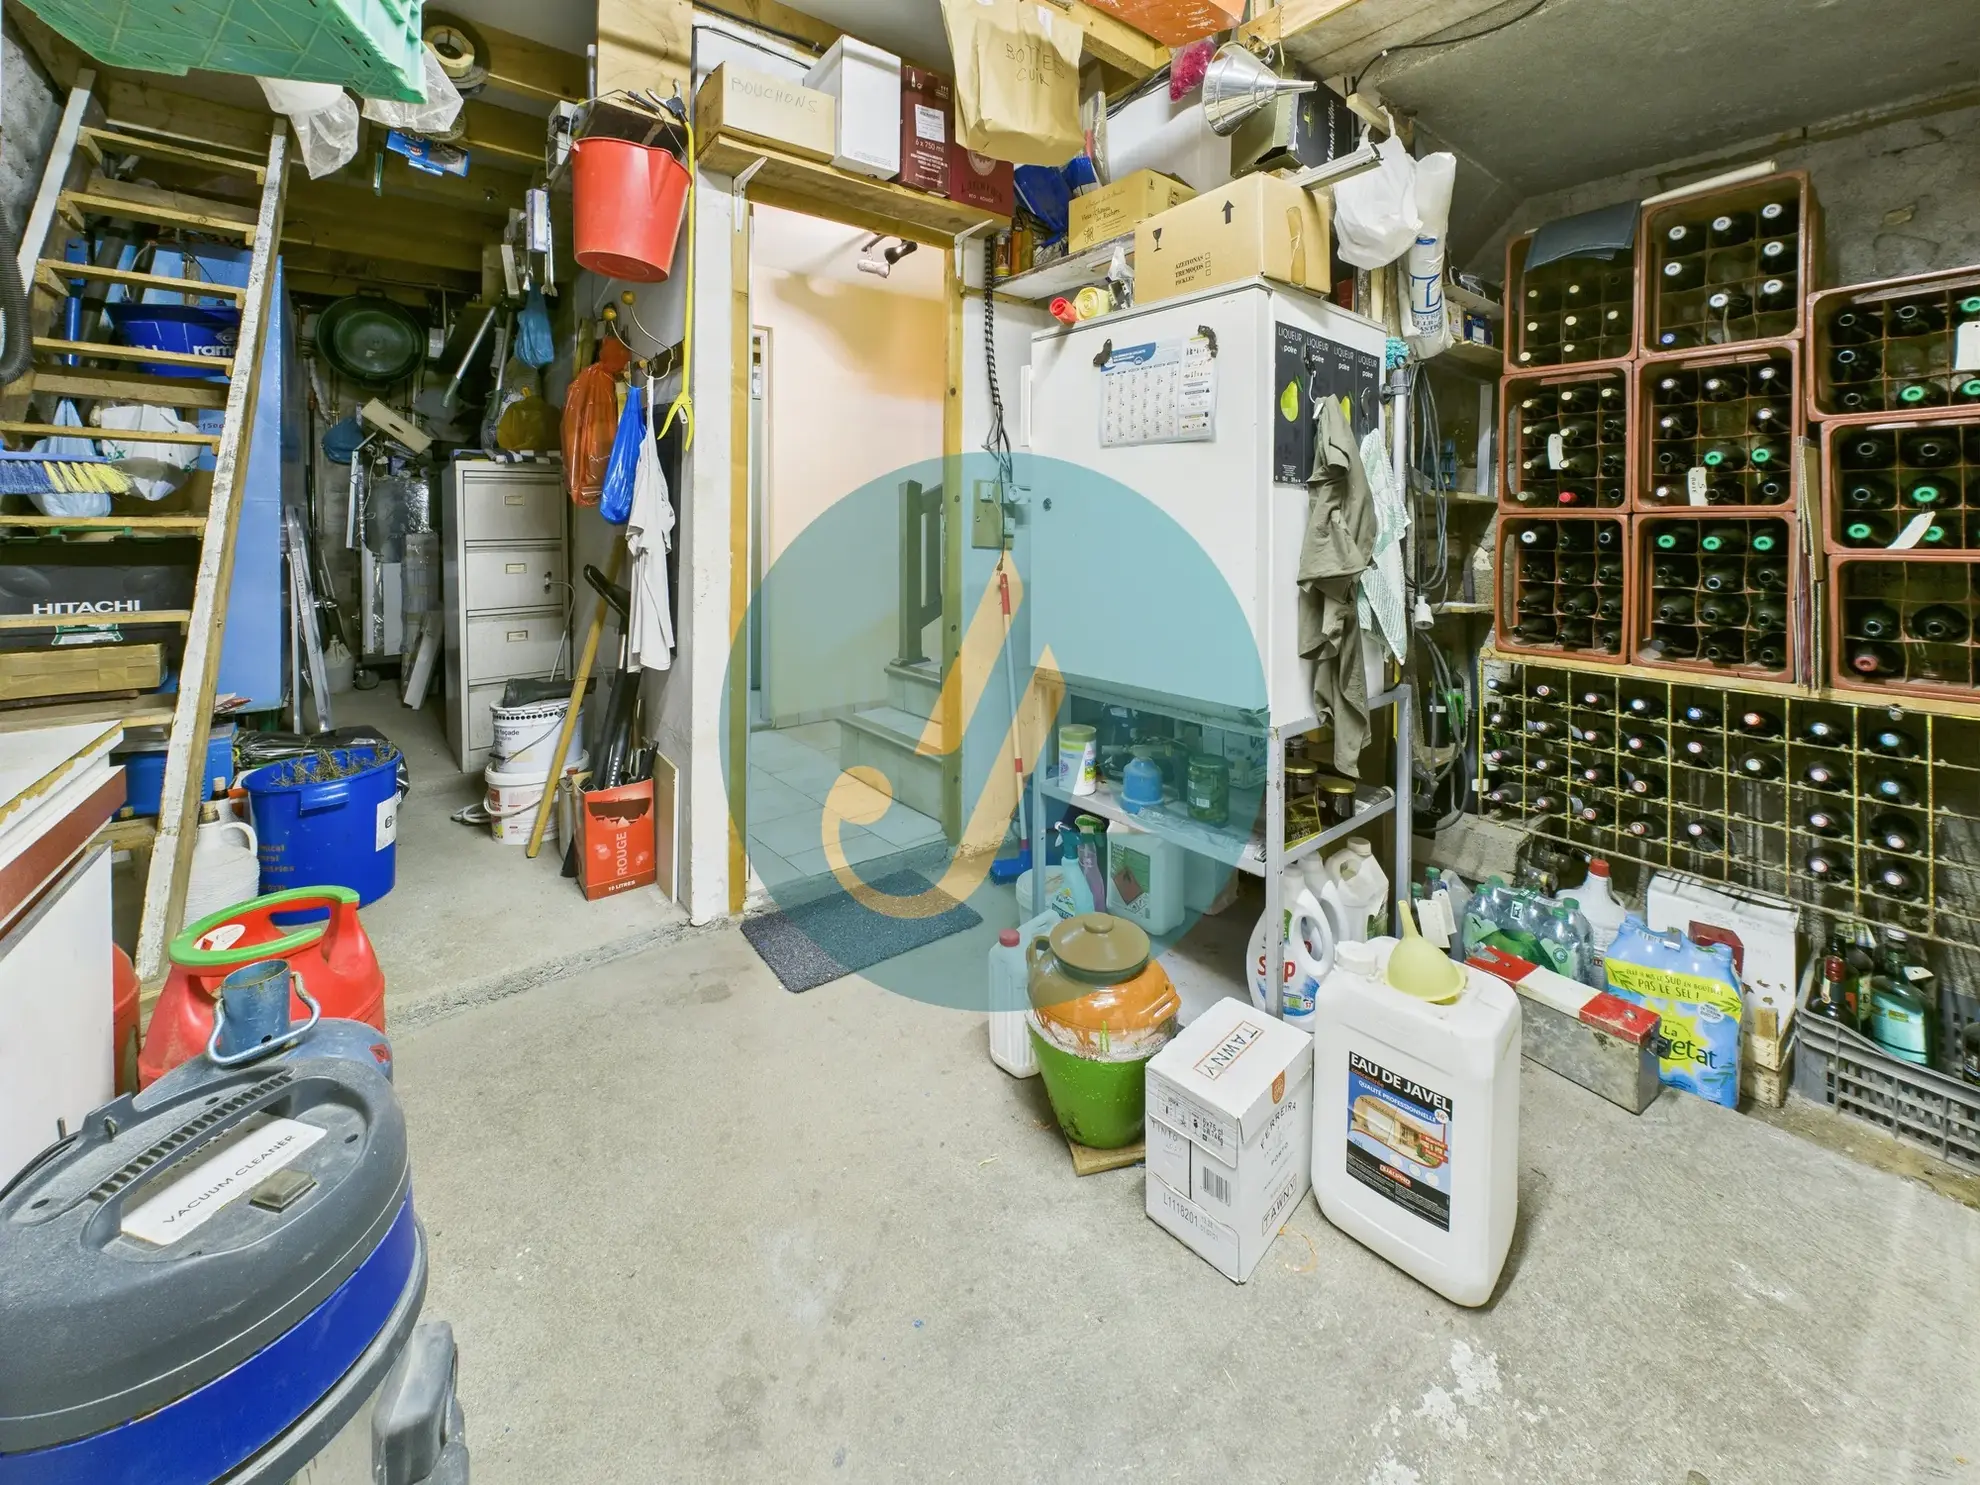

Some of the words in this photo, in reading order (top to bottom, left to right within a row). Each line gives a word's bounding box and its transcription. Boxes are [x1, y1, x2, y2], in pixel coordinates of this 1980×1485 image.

[1005, 43, 1065, 79] BOTTES
[1016, 67, 1050, 87] CUIR
[730, 76, 819, 114] BOUCHONS
[925, 141, 936, 151] 750
[1175, 255, 1204, 269] AZEITONAS
[1175, 275, 1195, 286] PICKLES
[1278, 326, 1302, 342] LIQUEUR
[193, 345, 234, 357] ram
[1283, 345, 1298, 355] poire
[1306, 337, 1329, 352] LIQUEUR
[1312, 354, 1325, 363] poire
[1333, 346, 1354, 360] LIQUEUR
[1338, 363, 1350, 371] poire
[1358, 355, 1377, 368] LIQUEUR
[1362, 370, 1373, 379] poire
[32, 600, 140, 615] HITACHI
[616, 831, 628, 876] ROUGE
[1257, 954, 1296, 983] Sp
[1665, 975, 1681, 986] SUD
[1638, 978, 1656, 992] PAS
[1659, 984, 1670, 995] LE
[1675, 987, 1692, 999] SEL
[1664, 1025, 1678, 1037] La
[1203, 1028, 1259, 1076] TAWNY
[1351, 1053, 1379, 1077] EAU
[1381, 1068, 1402, 1090] DE
[1403, 1081, 1451, 1113] JAVEL
[1151, 1118, 1178, 1142] TINTO
[1260, 1101, 1297, 1150] FERREIRA
[162, 1177, 235, 1224] VACUUM
[234, 1134, 297, 1177] CLEANER
[1163, 1192, 1198, 1227] L1118201
[1263, 1178, 1296, 1228] TAWNY
